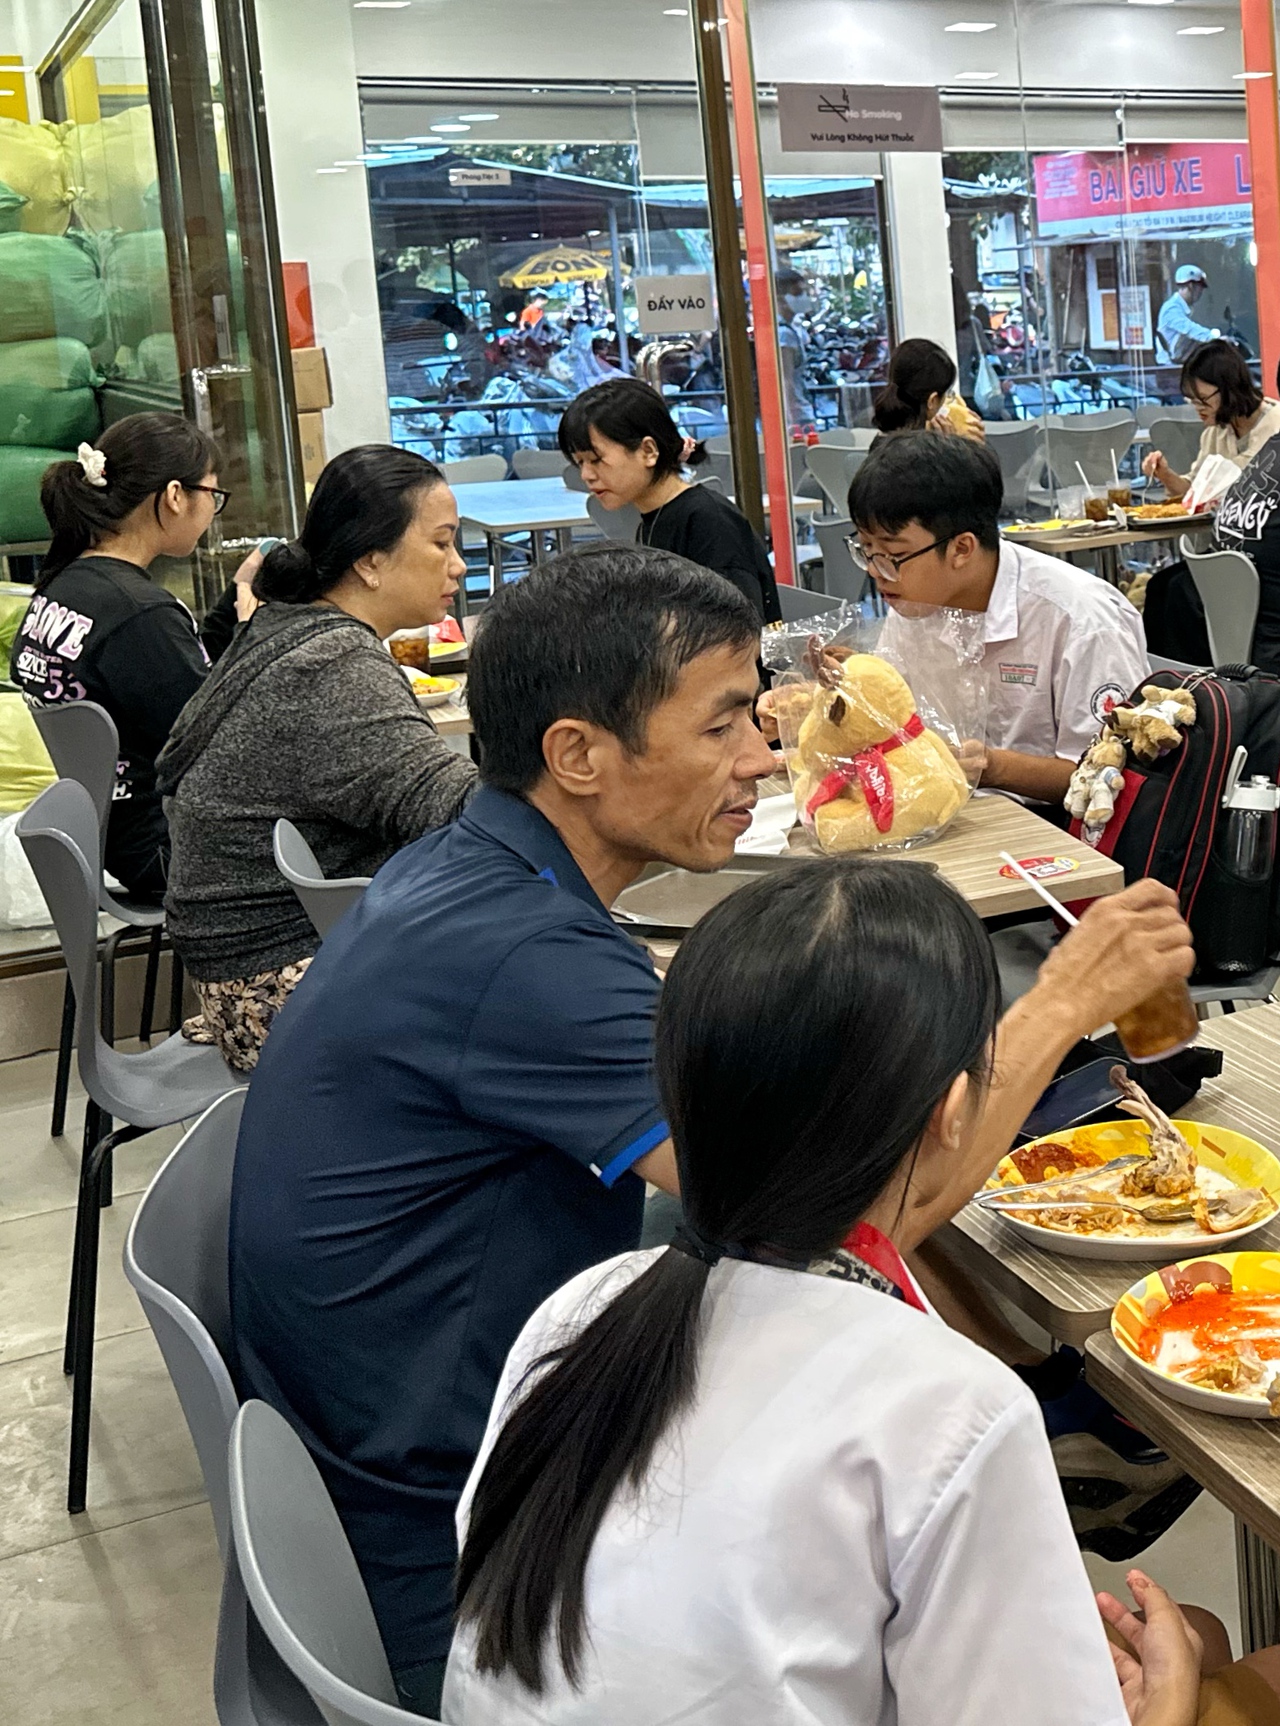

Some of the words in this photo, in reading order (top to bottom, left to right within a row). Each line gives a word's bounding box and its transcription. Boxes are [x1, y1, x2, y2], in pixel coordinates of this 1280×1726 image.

[861, 109, 902, 121] Smoking
[811, 133, 824, 141] Vui
[825, 133, 845, 143] Lòng
[847, 132, 873, 143] Không
[891, 132, 914, 142] Thuốc
[1173, 158, 1203, 195] XE
[678, 295, 706, 309] VÀO
